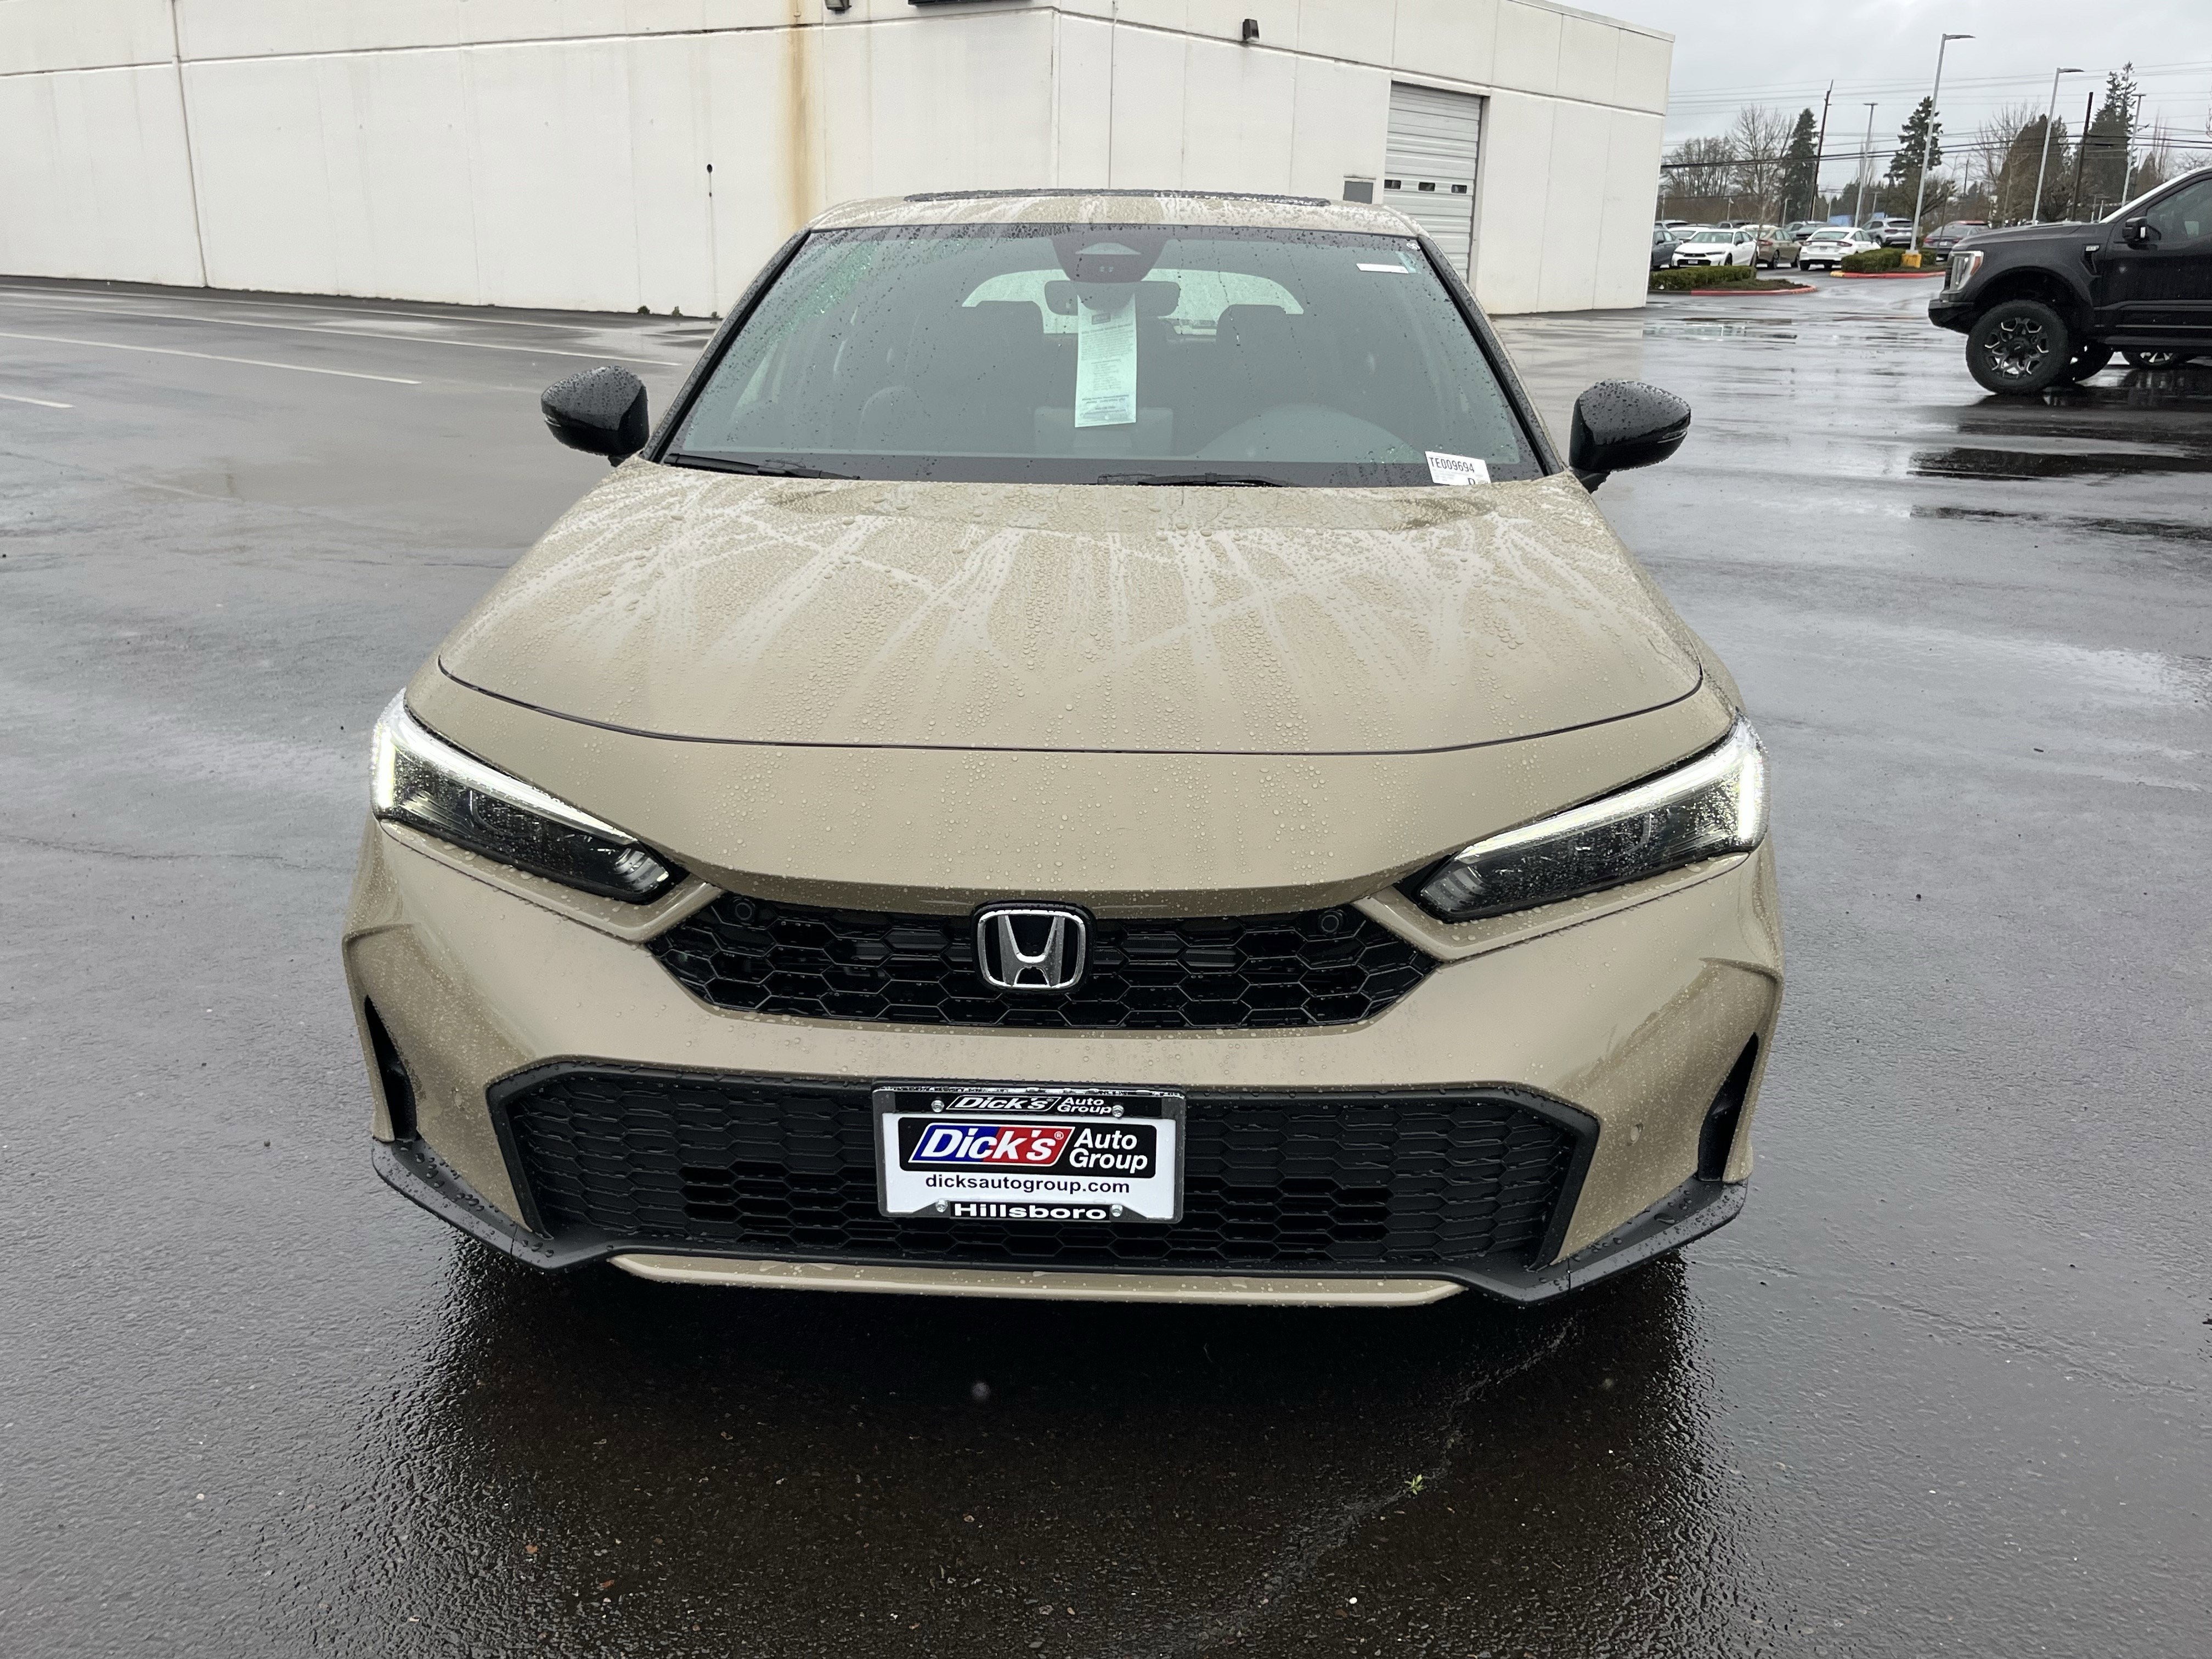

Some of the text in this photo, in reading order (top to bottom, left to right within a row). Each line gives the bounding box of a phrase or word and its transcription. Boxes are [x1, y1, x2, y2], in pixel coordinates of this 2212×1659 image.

[1429, 457, 1475, 473] TE009694
[1057, 1103, 1113, 1115] Group
[1061, 1097, 1104, 1105] Auto
[1074, 1128, 1137, 1150] Auto
[1069, 1148, 1148, 1173] Group
[926, 1174, 1130, 1194] dicksautogroup.com
[955, 1203, 1107, 1220] Hillsboro
